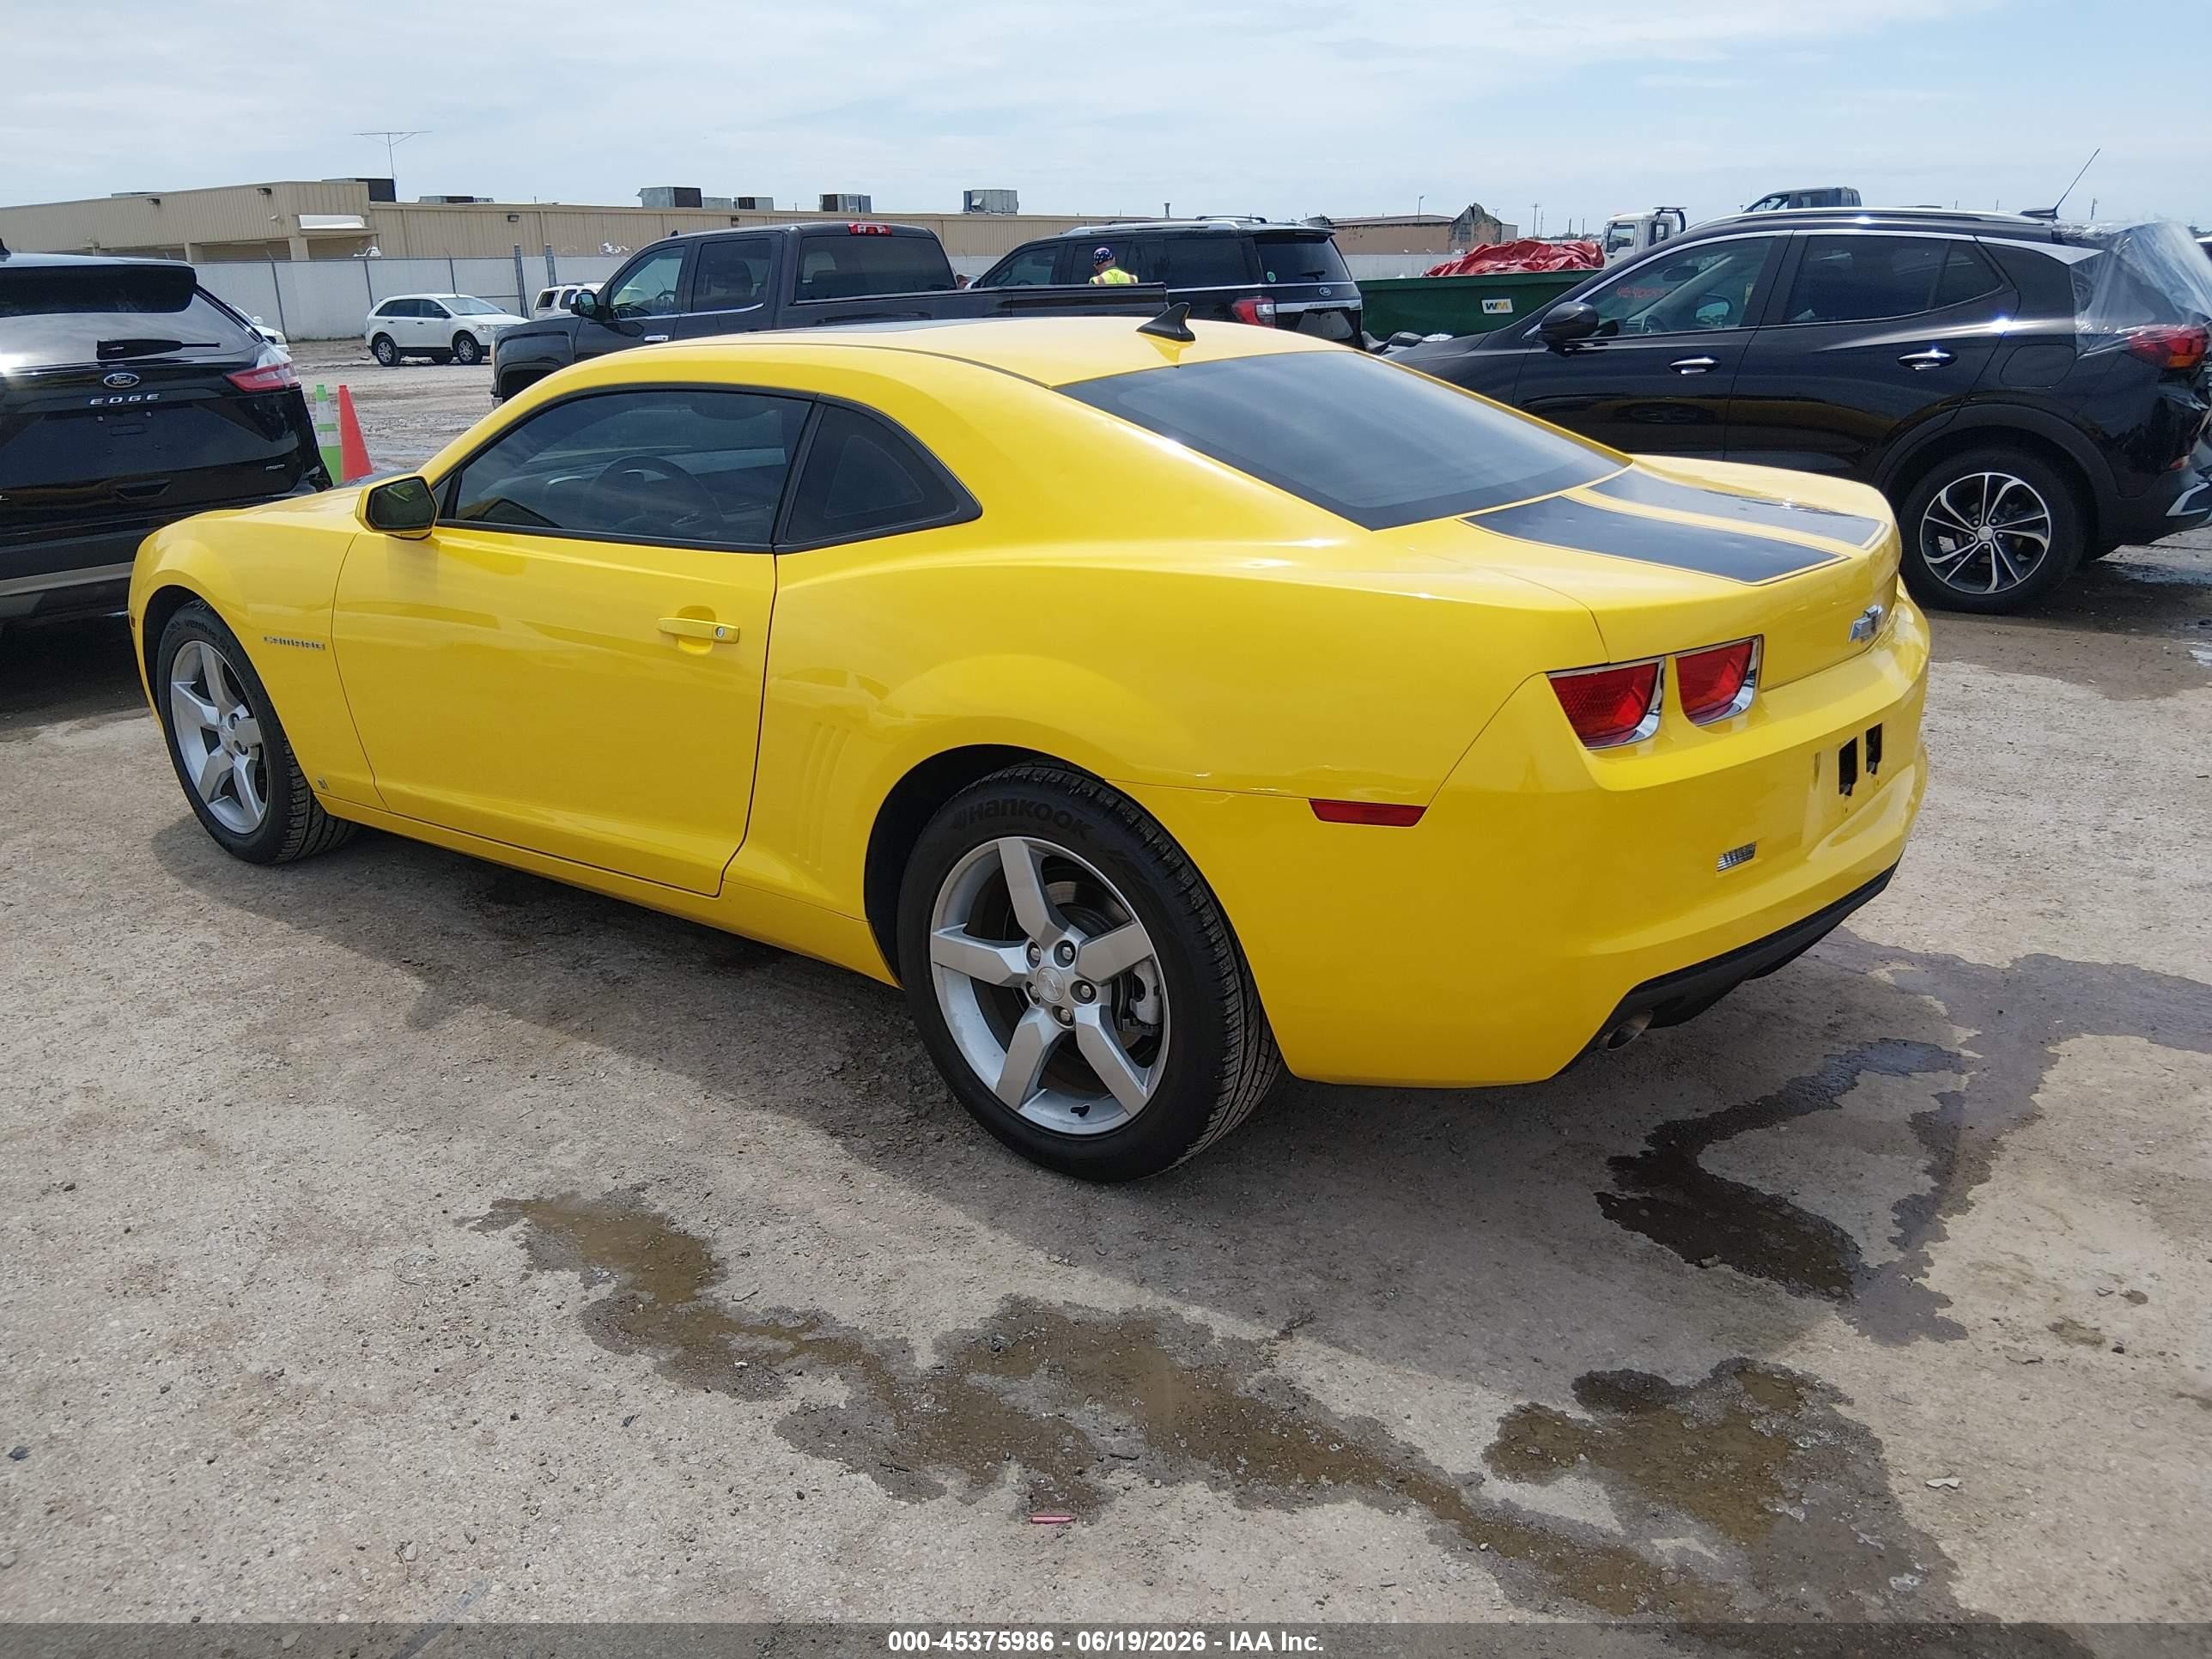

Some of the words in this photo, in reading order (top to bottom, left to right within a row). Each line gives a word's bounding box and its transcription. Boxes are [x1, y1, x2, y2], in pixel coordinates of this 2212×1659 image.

[1486, 301, 1510, 310] WM
[112, 375, 131, 385] Ford
[89, 393, 160, 405] EDGE
